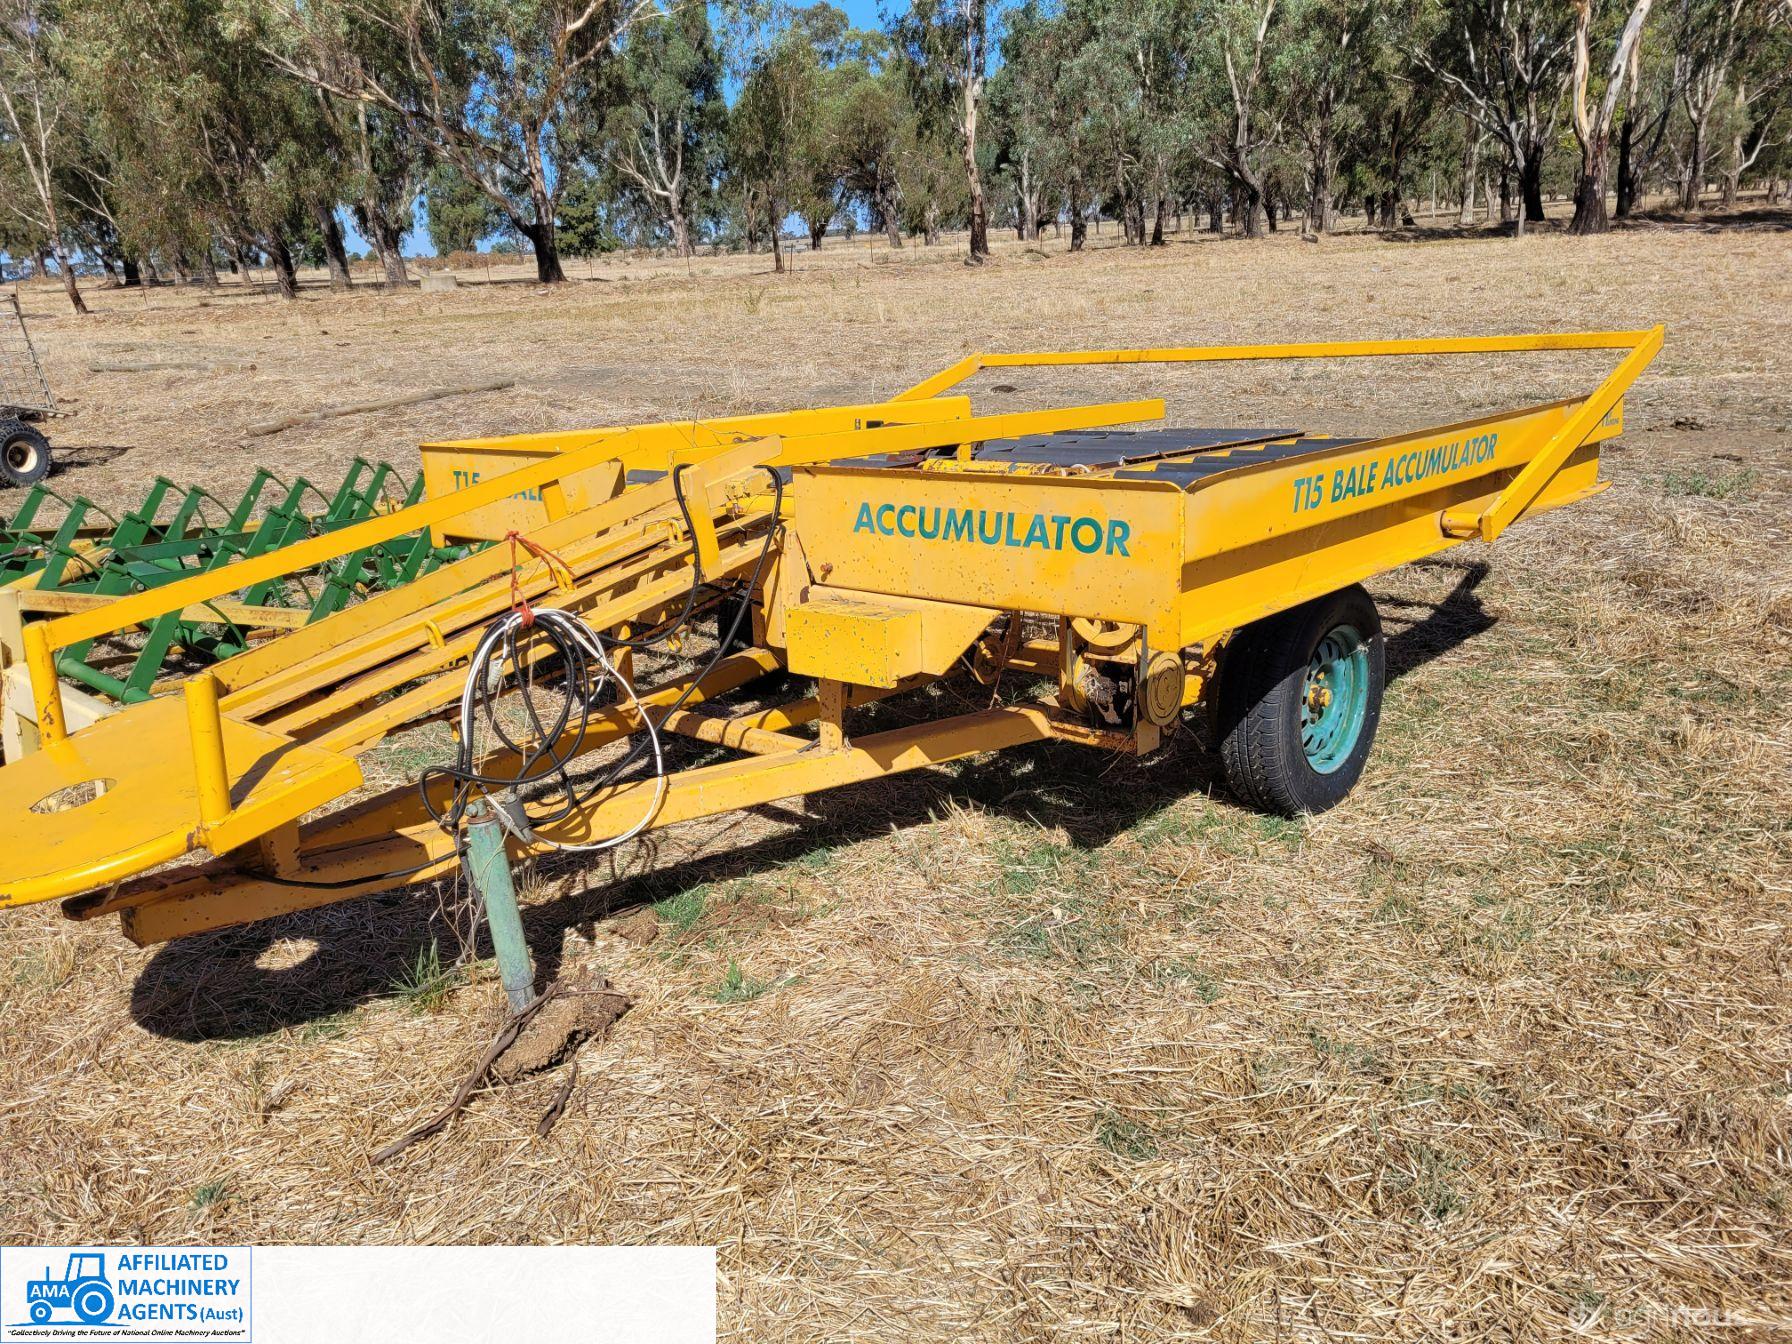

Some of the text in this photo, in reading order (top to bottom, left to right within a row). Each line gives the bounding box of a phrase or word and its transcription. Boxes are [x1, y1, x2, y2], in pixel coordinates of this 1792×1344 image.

[1292, 433, 1499, 513] T15 BALE ACCUMULATOR
[853, 502, 1131, 557] ACCUMULATOR
